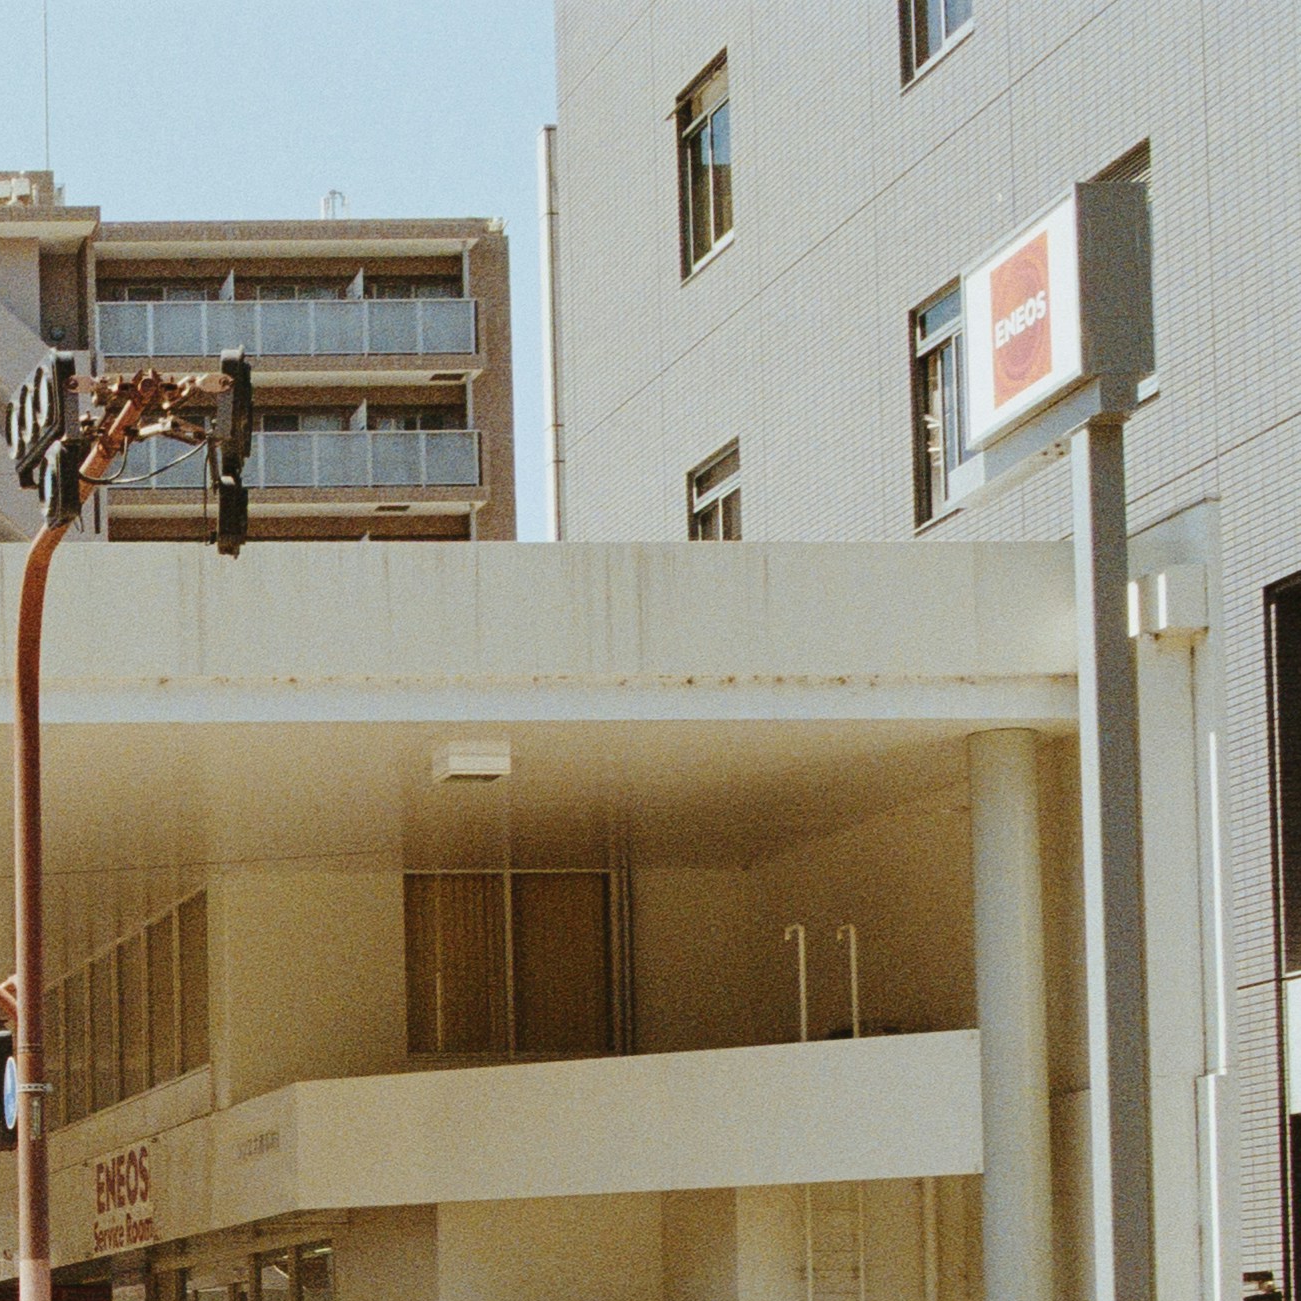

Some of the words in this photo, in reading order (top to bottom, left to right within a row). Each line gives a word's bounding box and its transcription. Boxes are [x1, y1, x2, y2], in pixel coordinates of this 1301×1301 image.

[995, 291, 1047, 349] ENEOS
[96, 1145, 149, 1214] ENEOS
[94, 1222, 125, 1253] Service
